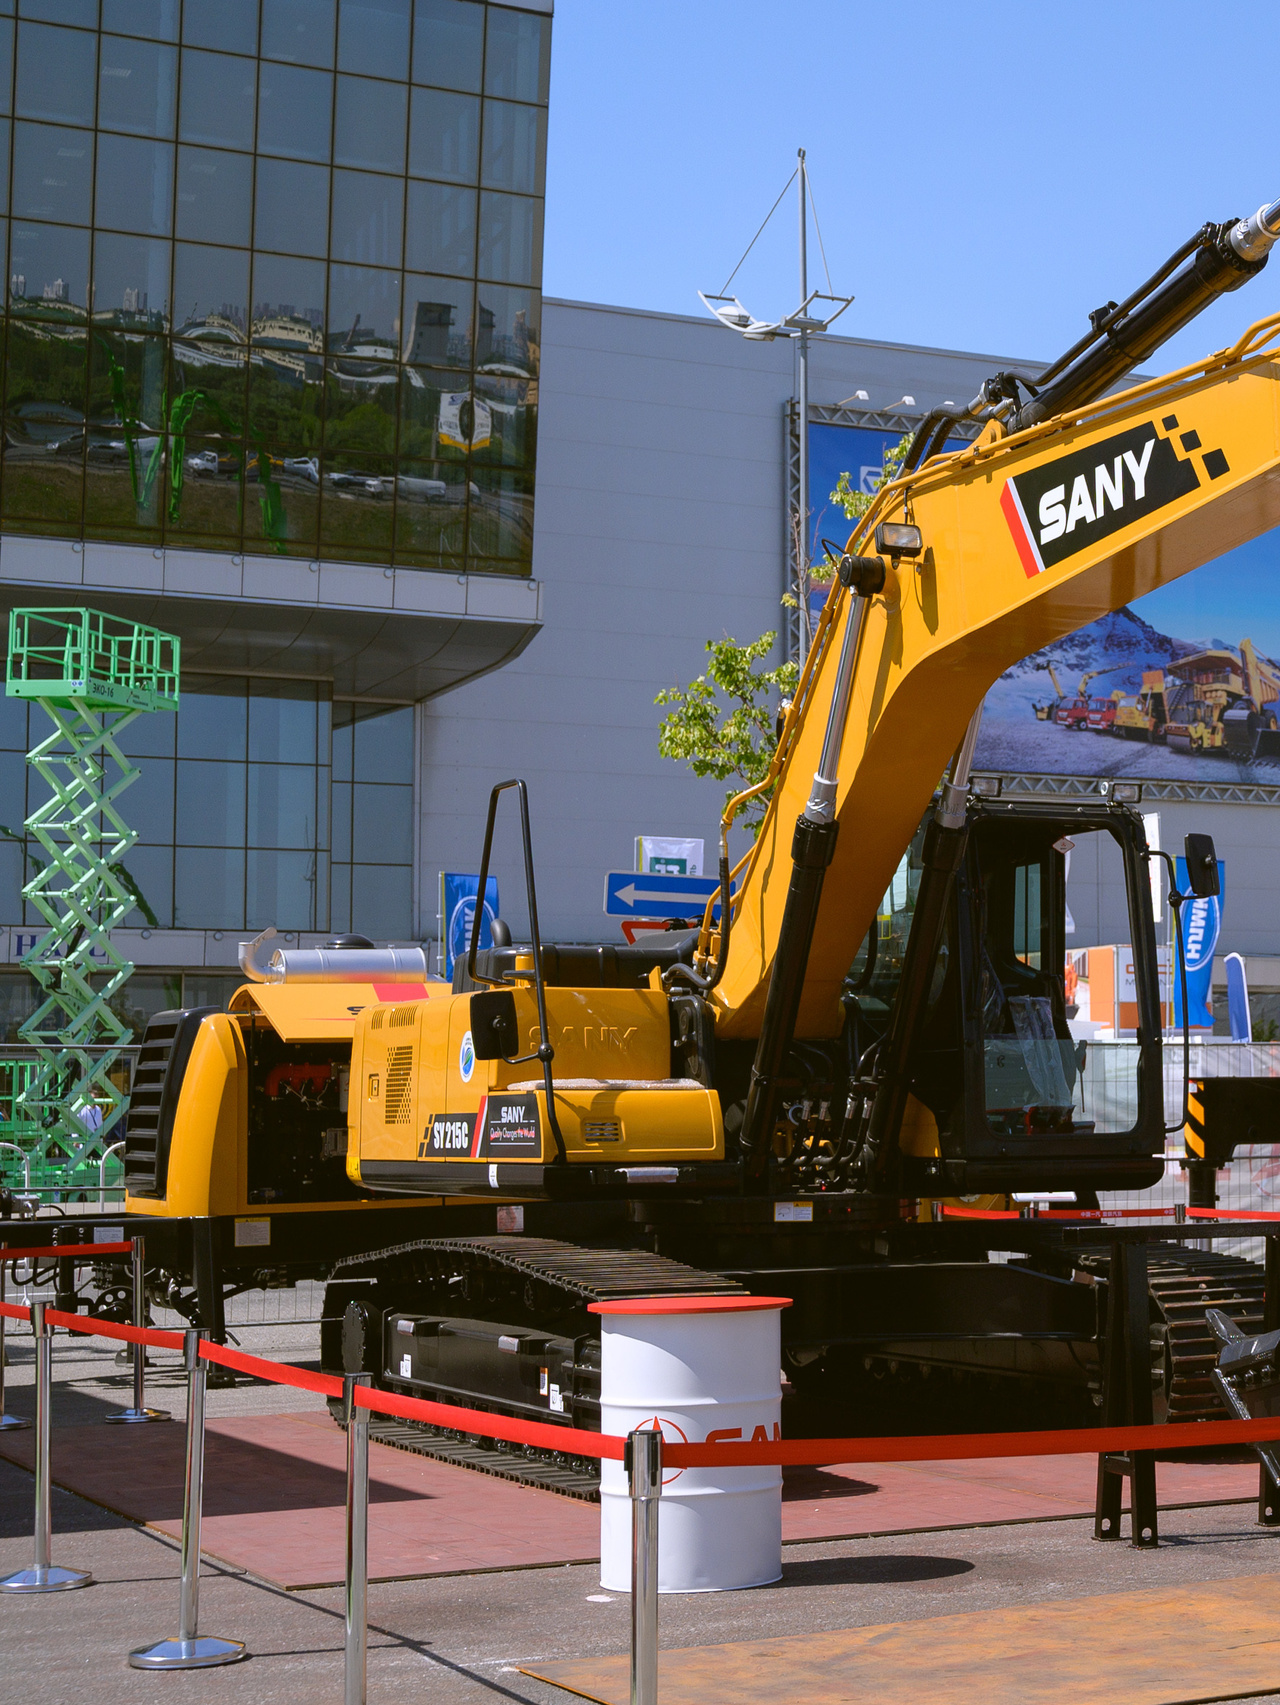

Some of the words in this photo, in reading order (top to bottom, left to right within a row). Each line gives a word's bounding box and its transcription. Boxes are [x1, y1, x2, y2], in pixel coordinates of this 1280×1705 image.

[1039, 438, 1156, 546] SANY
[92, 683, 114, 698] ЭКО-16
[529, 1026, 637, 1050] SANY
[500, 1106, 526, 1123] SANY
[490, 1126, 503, 1141] Quality
[503, 1126, 517, 1141] Changes
[523, 1126, 535, 1138] World
